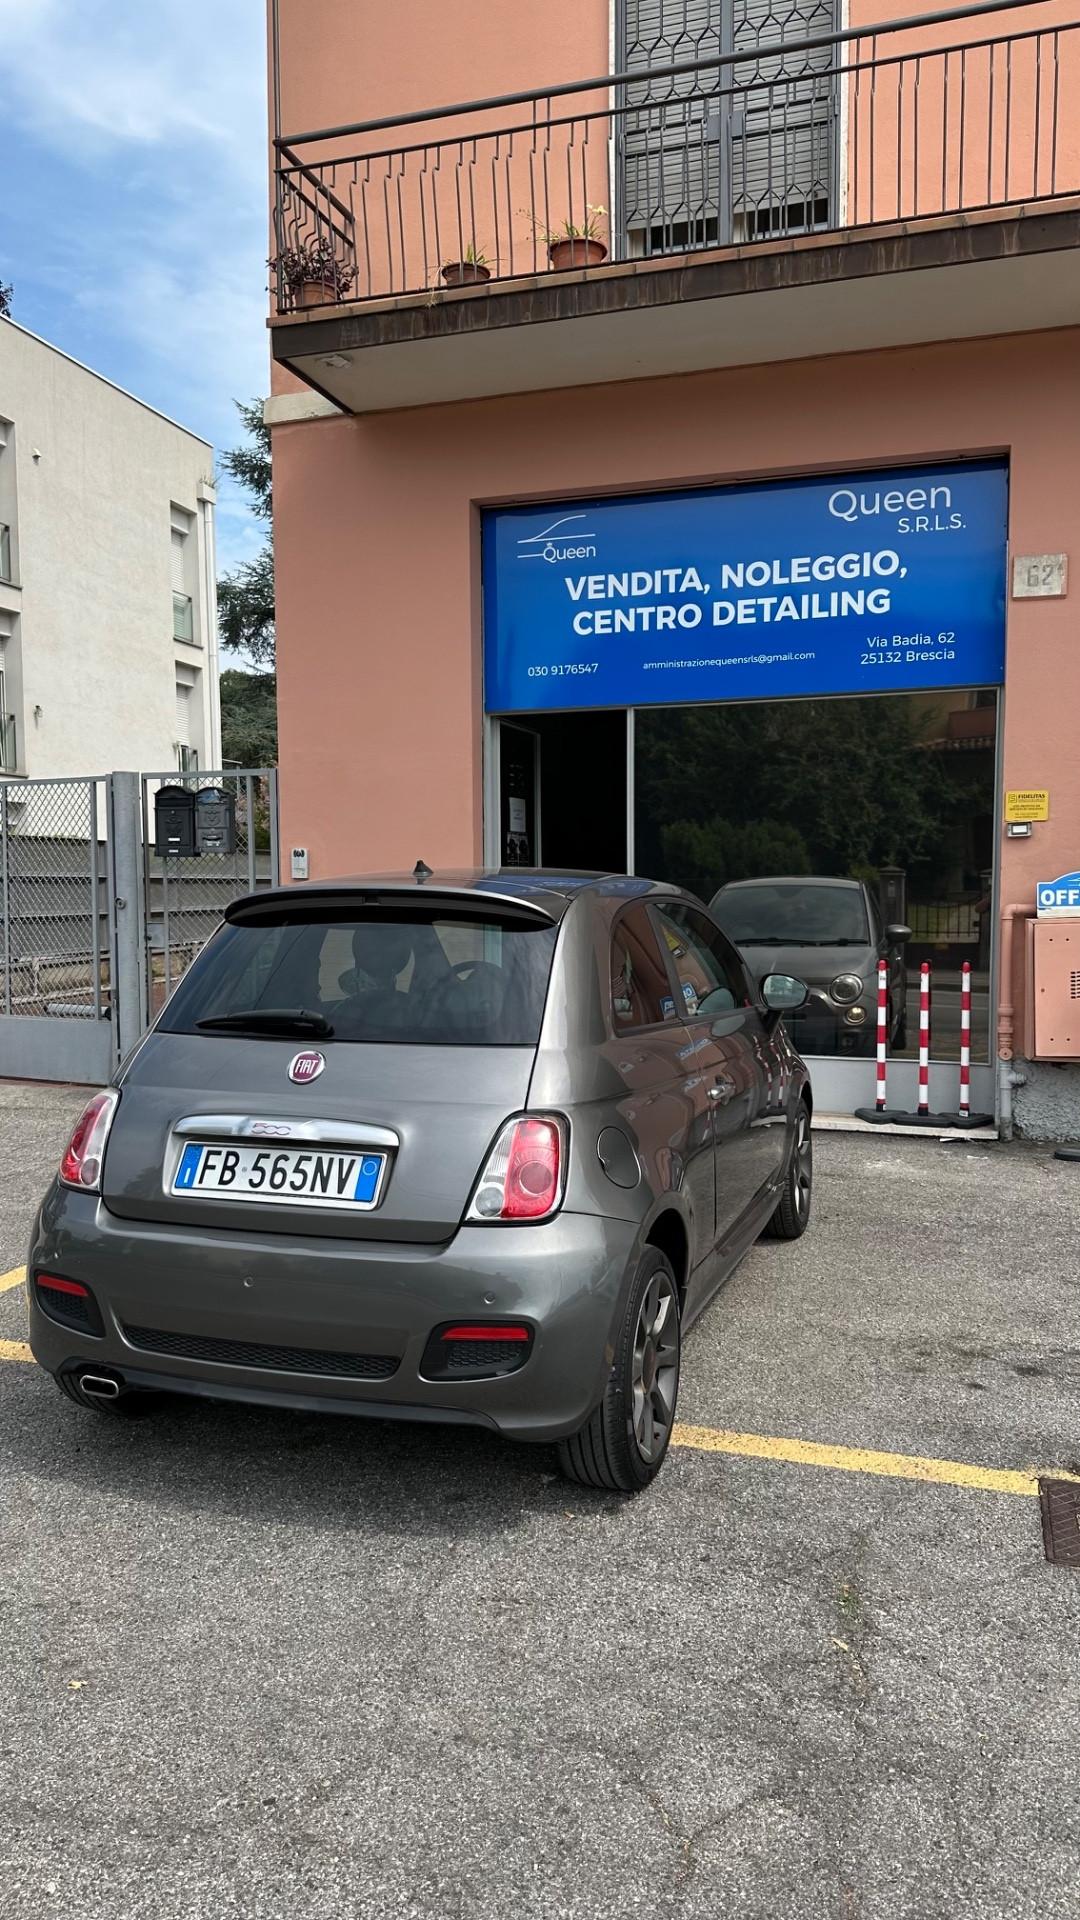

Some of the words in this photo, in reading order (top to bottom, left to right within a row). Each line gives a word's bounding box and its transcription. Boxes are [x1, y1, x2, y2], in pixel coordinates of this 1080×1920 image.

[829, 487, 951, 521] Queen
[898, 514, 967, 534] S.R.L.S.
[543, 545, 596, 564] Queen
[565, 568, 710, 601] VENDITA,
[722, 550, 908, 588] NOLEGGIO,
[574, 602, 703, 635] CENTRO
[713, 589, 891, 625] DETAILING
[867, 636, 888, 648] Via
[893, 633, 934, 647] Badia,
[938, 633, 955, 643] 62
[643, 652, 816, 670] amministrazionequeensrls@gmail.com
[861, 652, 902, 665] 25132
[907, 649, 955, 662] Brescia
[527, 666, 549, 677] 030
[551, 663, 599, 676] 9176547
[1041, 889, 1080, 906] OFF
[295, 1059, 319, 1074] FIAT
[251, 1122, 291, 1136] 500
[198, 1150, 240, 1186] FB
[248, 1153, 356, 1196] 565NV
